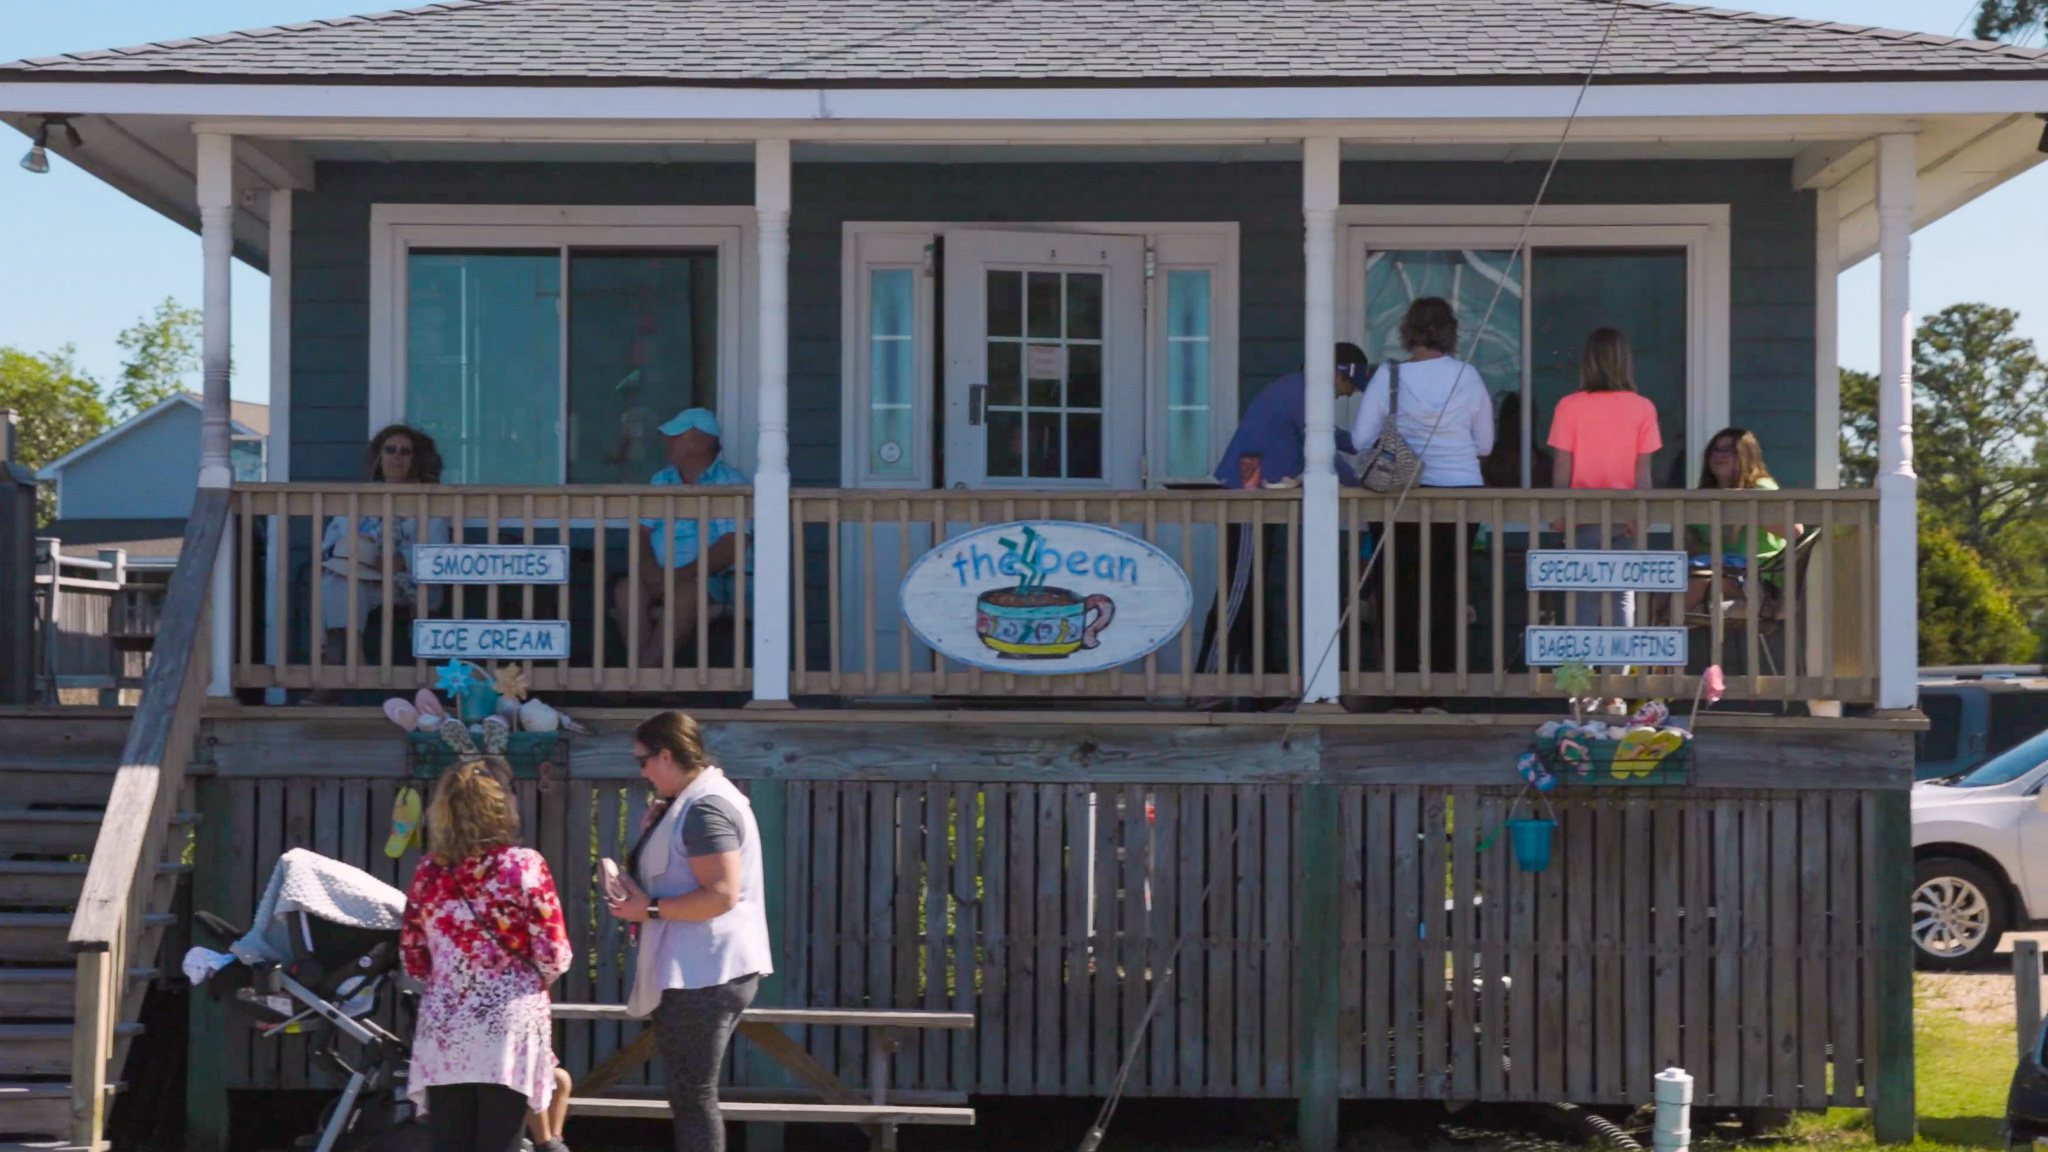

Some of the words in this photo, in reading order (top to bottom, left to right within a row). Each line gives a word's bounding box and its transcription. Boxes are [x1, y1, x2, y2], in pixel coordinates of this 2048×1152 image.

[432, 553, 549, 576] SMOOTHIES
[952, 544, 1019, 586] the
[1034, 533, 1138, 585] bean
[1538, 560, 1616, 583] SPECIALTY
[1621, 560, 1676, 584] COFFEE
[431, 628, 469, 651] ICE
[478, 628, 553, 651] CREAM
[1538, 635, 1591, 658] BAGELS
[1597, 635, 1605, 657] &
[1611, 635, 1677, 657] MUFFINS
